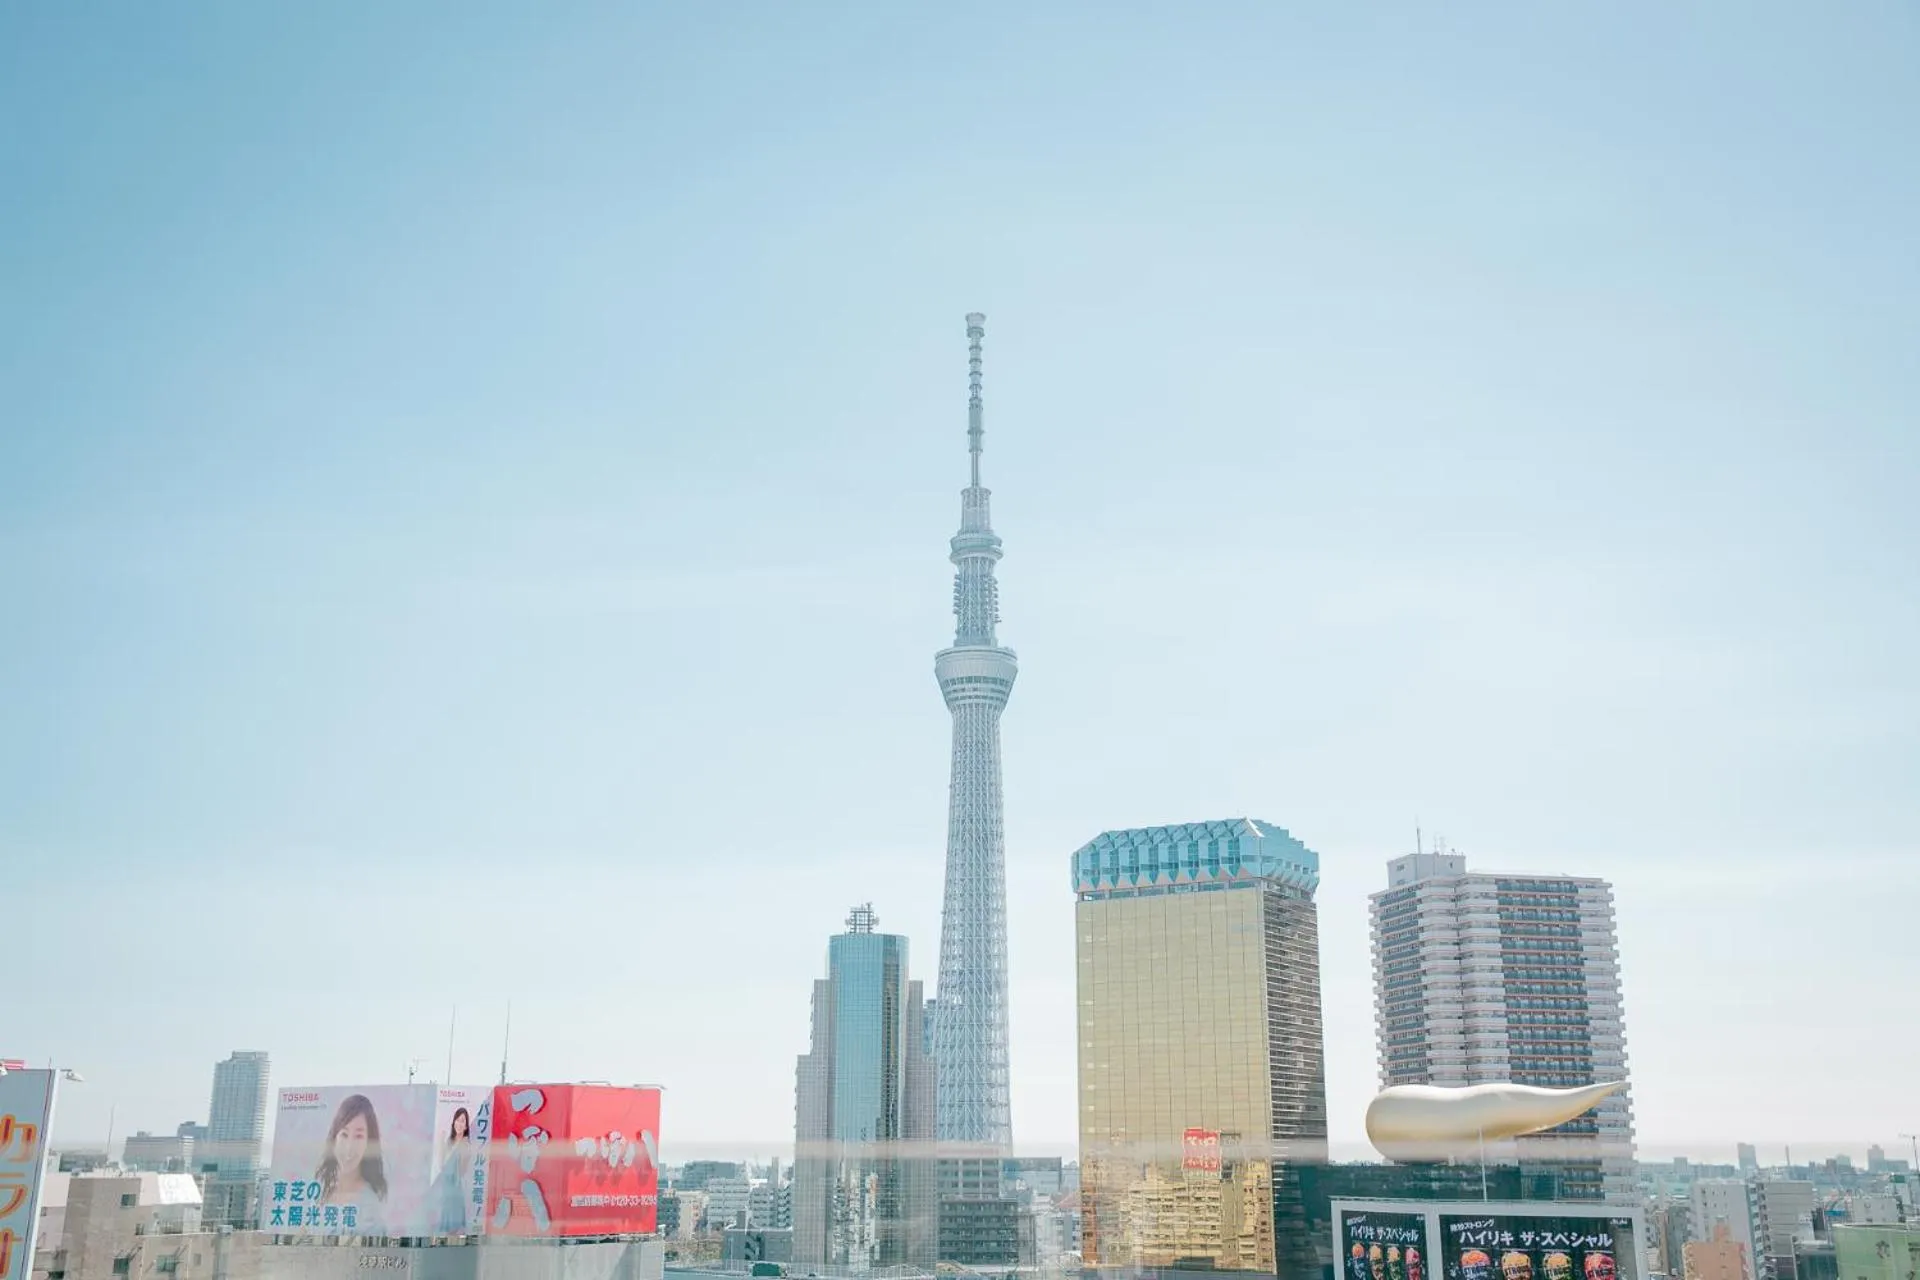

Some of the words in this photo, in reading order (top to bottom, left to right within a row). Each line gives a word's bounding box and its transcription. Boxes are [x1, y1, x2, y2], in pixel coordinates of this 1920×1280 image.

[283, 1092, 320, 1103] TOSHIBA
[574, 1128, 660, 1169] つぼ八
[493, 1089, 550, 1231] つぼ八
[272, 1181, 321, 1202] 東芝の
[270, 1205, 358, 1228] 太陽光発電
[1350, 1225, 1376, 1240] ハイリキ
[1459, 1230, 1514, 1246] ハイリキ
[1520, 1231, 1613, 1248] ザ・スペシャル
